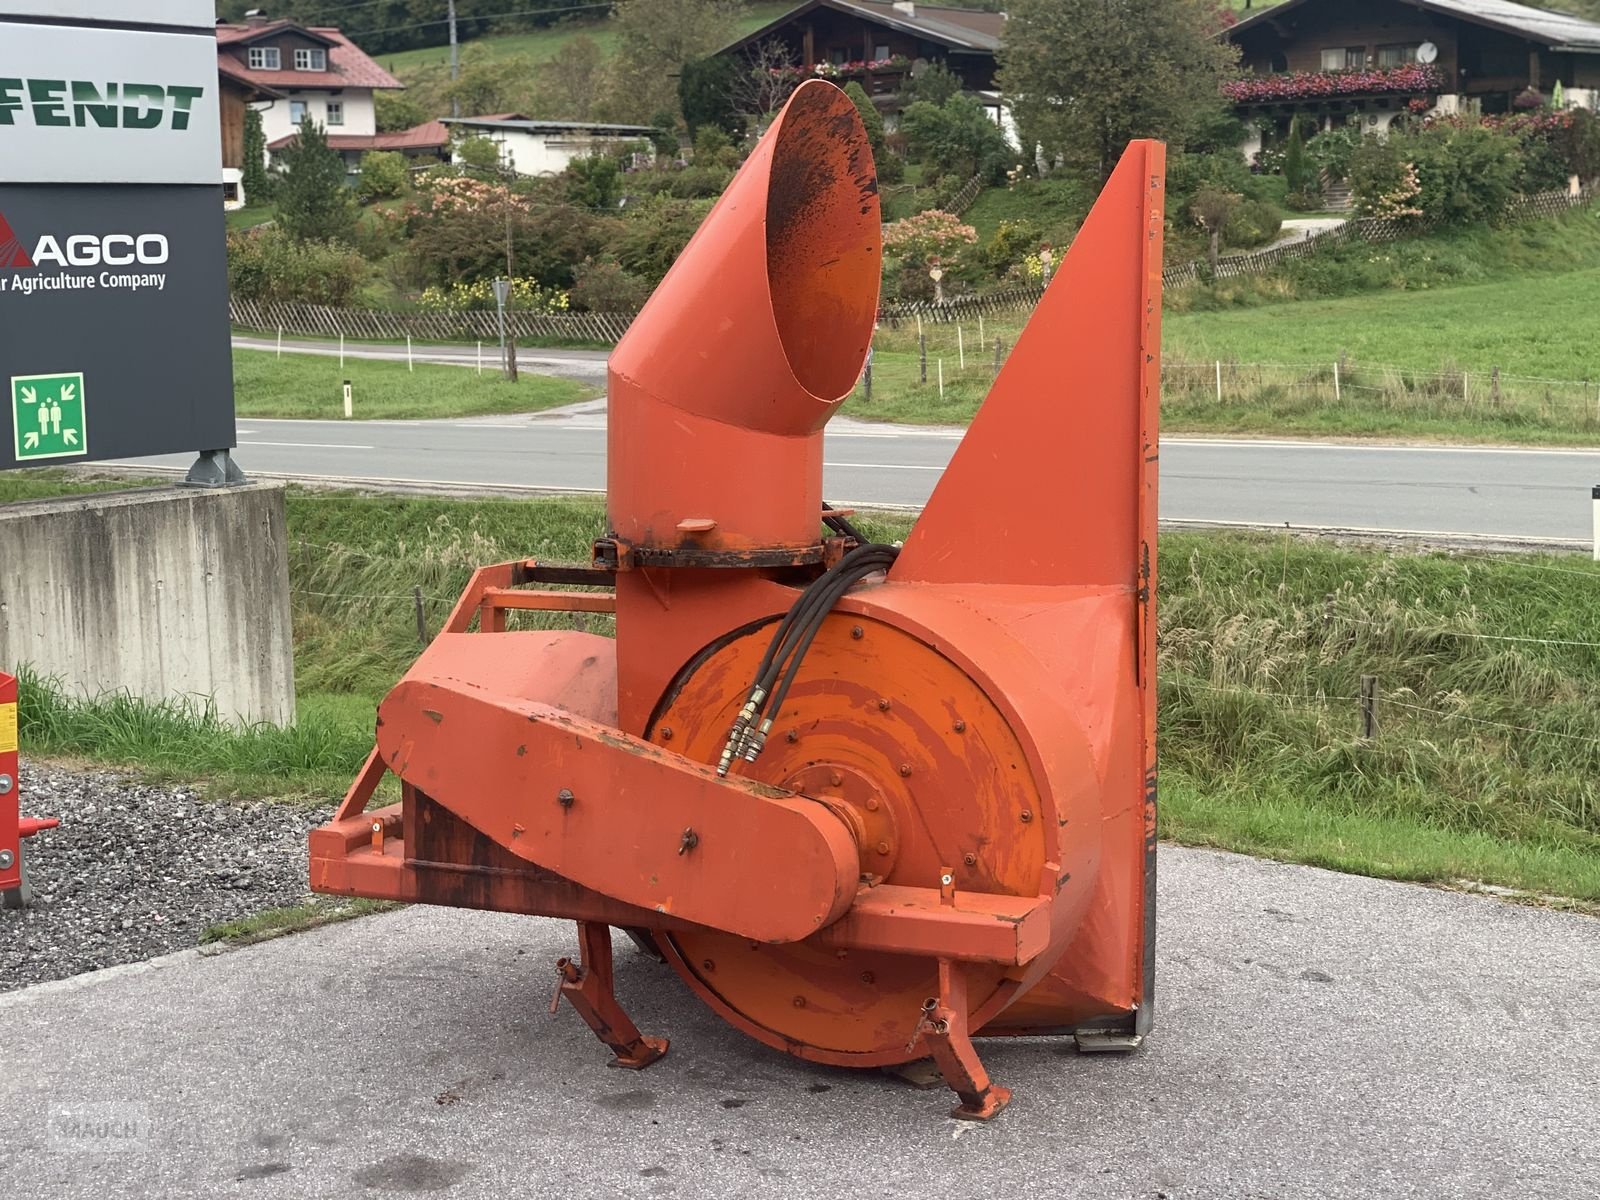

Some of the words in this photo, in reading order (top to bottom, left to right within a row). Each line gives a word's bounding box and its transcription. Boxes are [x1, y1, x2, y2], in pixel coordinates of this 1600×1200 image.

[0, 78, 204, 130] FENDT
[32, 234, 168, 266] AGCO
[11, 272, 96, 295] Agriculture
[99, 271, 166, 291] Company
